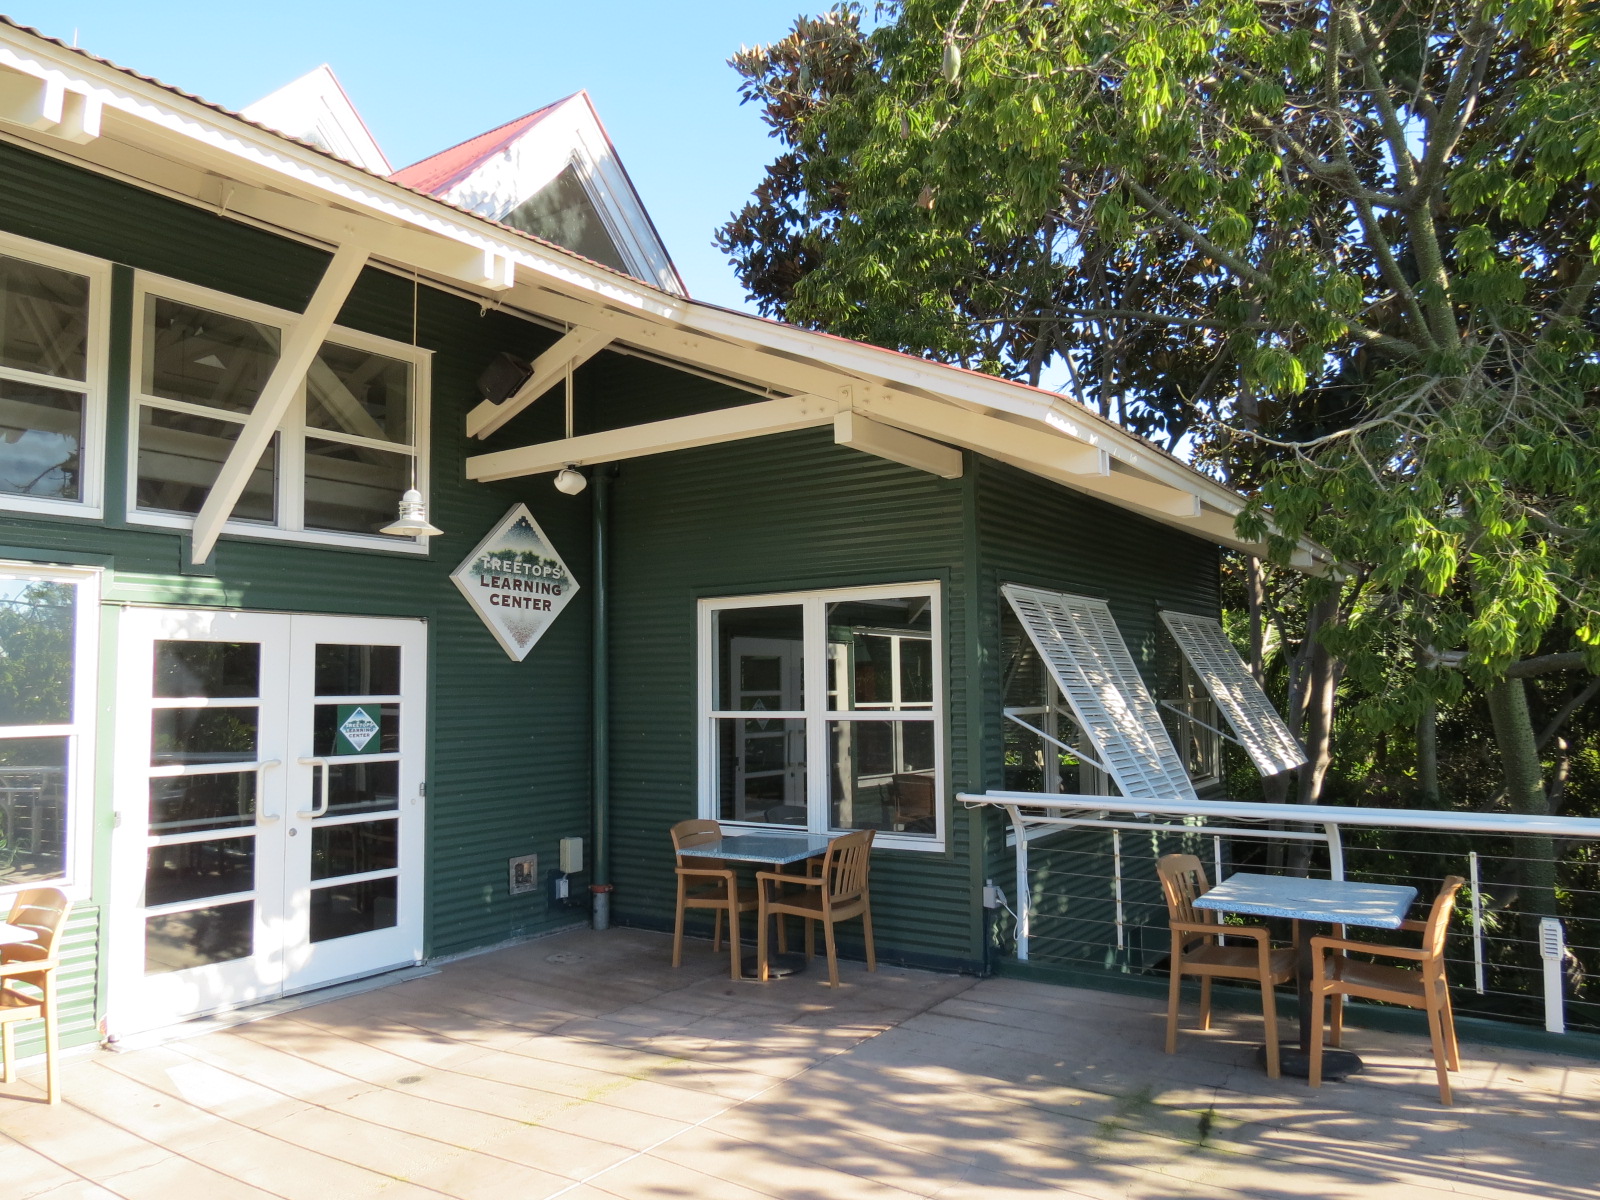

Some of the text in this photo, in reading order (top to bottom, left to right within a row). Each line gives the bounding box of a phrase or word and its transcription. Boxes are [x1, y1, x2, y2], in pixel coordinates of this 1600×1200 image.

[480, 557, 562, 579] TREETOPS
[480, 574, 562, 596] LEARNING
[489, 593, 552, 612] CENTER
